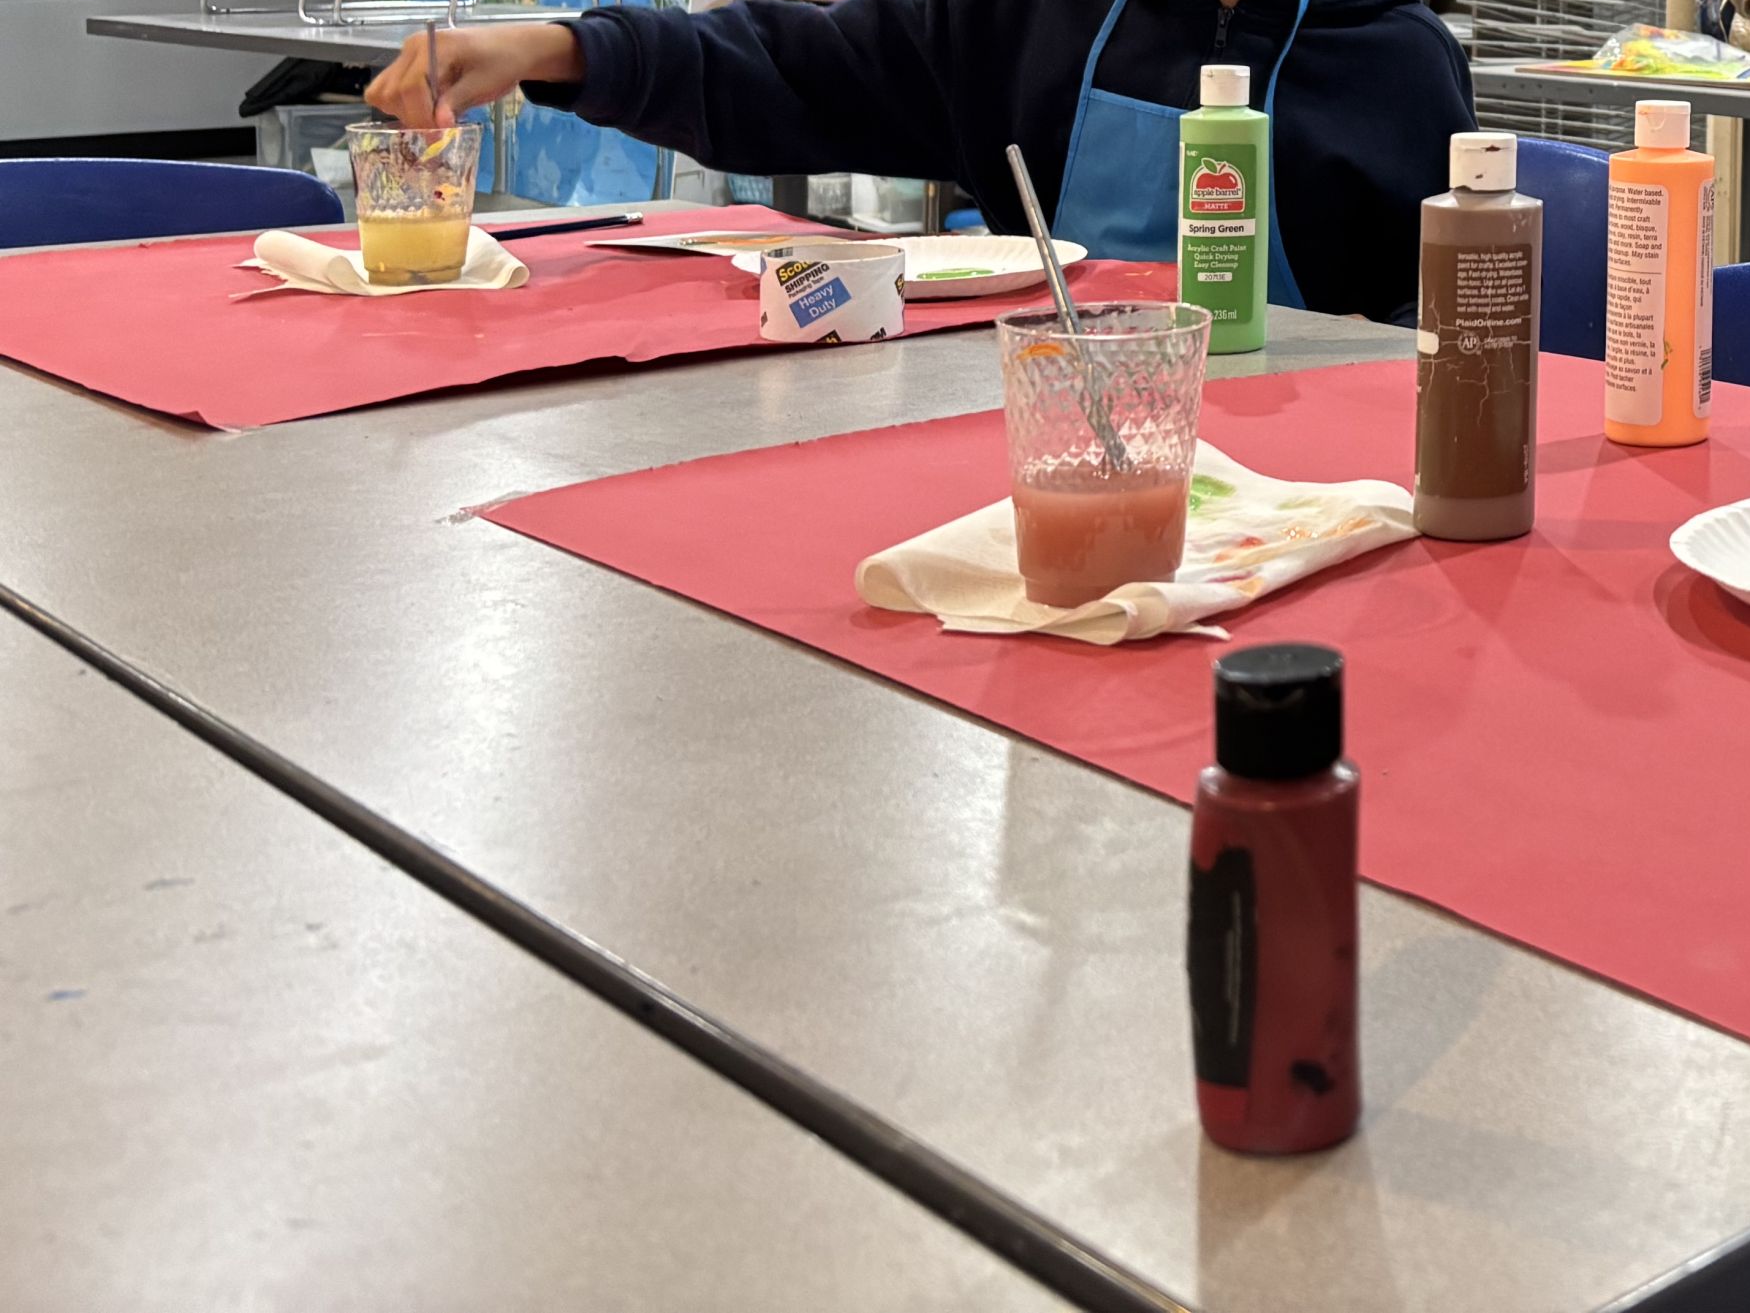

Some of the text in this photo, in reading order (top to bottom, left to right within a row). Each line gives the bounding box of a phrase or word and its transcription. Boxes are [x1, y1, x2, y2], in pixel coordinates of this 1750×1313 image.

[1194, 188, 1239, 197] apple barrel
[1627, 197, 1661, 205] Intermixable
[1189, 224, 1244, 234] Spring Green
[1188, 244, 1209, 252] Acrylic
[1632, 250, 1643, 259] May
[785, 263, 830, 293] SHIPPING
[798, 284, 833, 309] Heavy
[808, 298, 836, 318] Duty
[1456, 318, 1522, 327] PlaidOnline.com
[1462, 338, 1476, 348] AP
